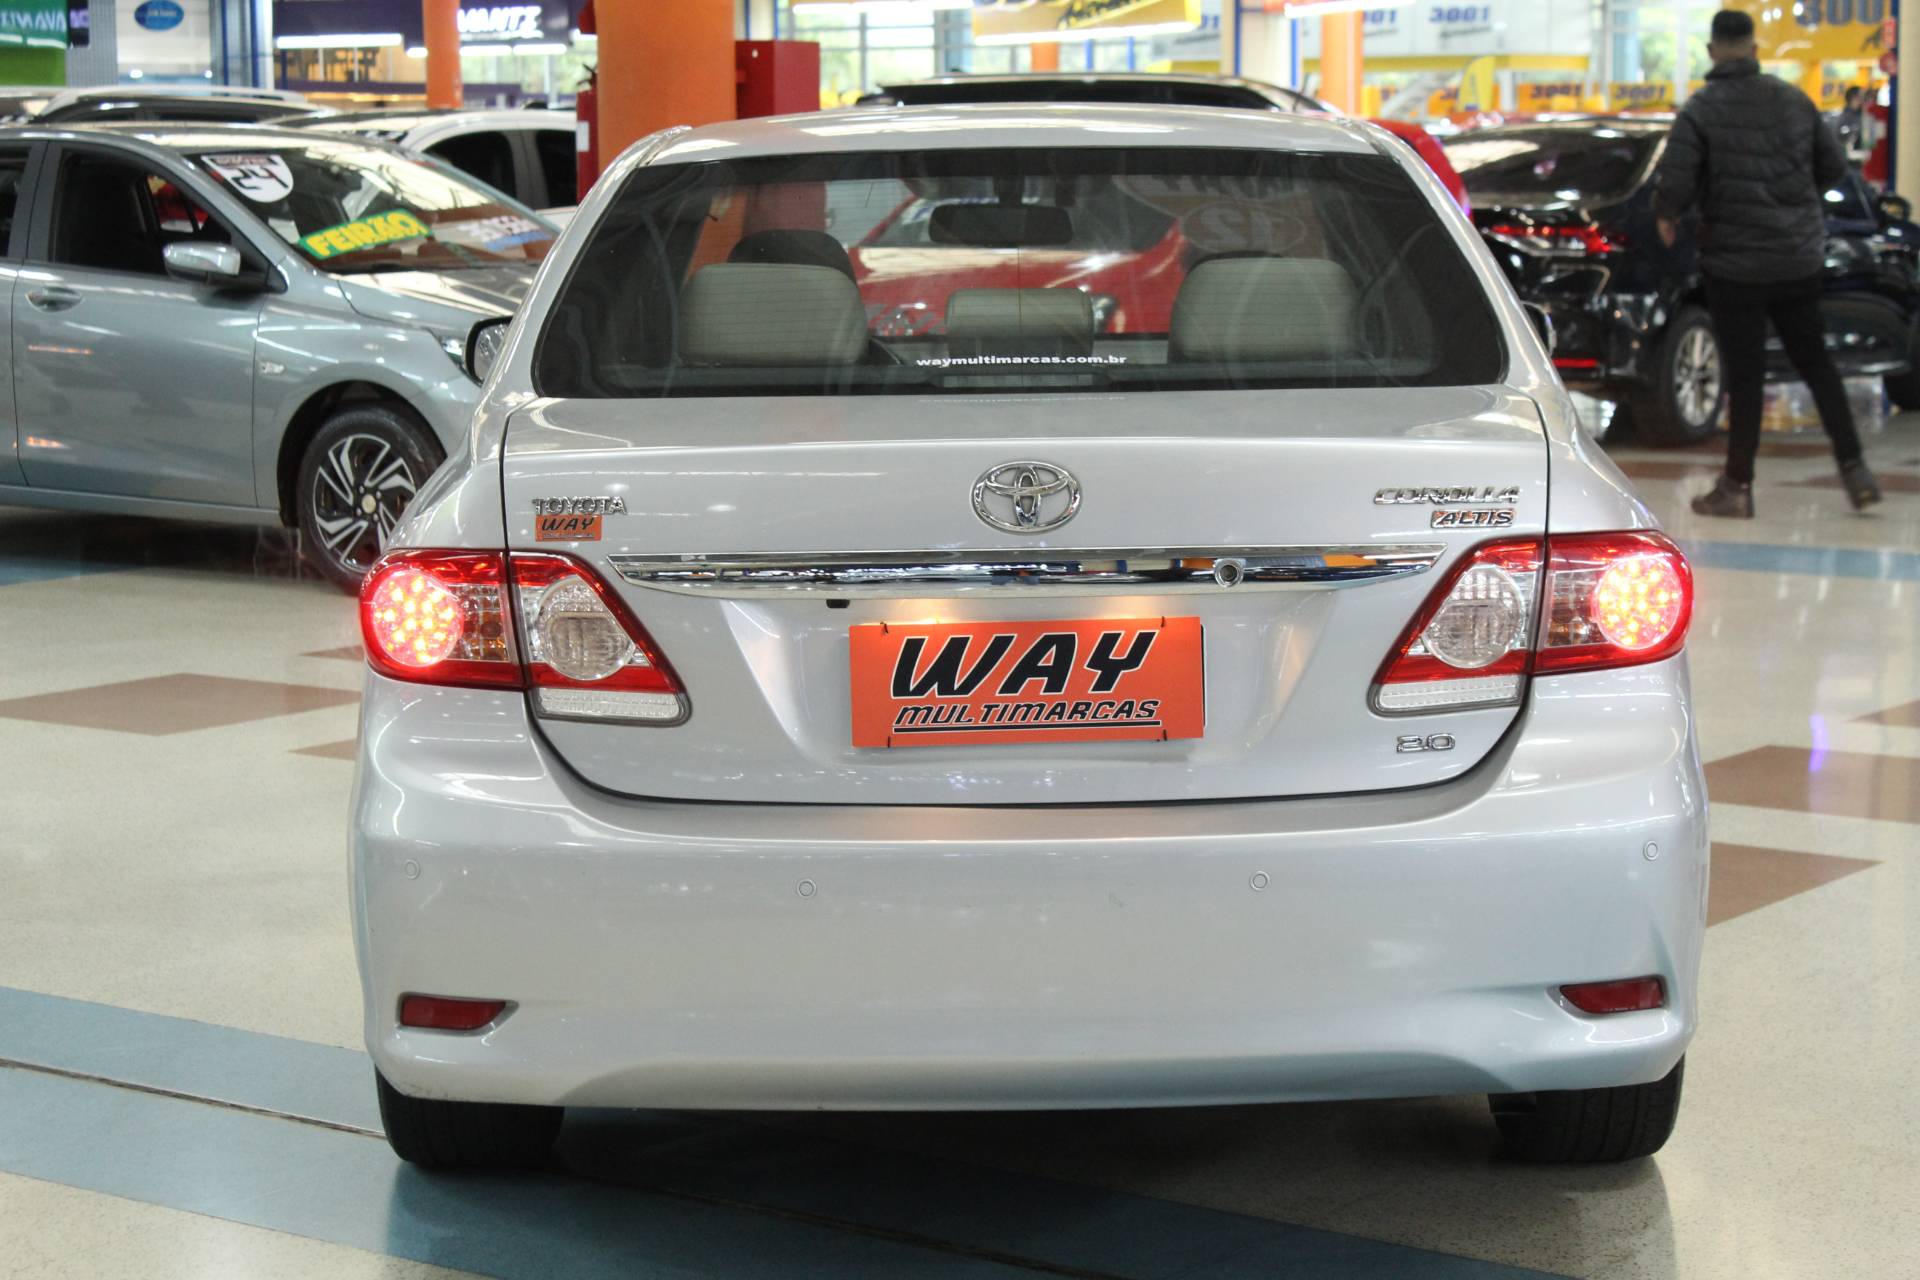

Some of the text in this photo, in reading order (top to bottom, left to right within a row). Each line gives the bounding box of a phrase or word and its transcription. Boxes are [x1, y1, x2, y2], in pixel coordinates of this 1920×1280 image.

[916, 355, 1127, 368] waymultimarcas.com.br
[1374, 486, 1519, 505] COROLLA
[532, 496, 627, 514] TOYOTA
[541, 518, 595, 531] WAY
[1437, 511, 1513, 525] ALTIS
[891, 630, 1161, 699] WAY
[893, 699, 1161, 726] MULTIMARCAS
[1396, 733, 1455, 753] 2.0
